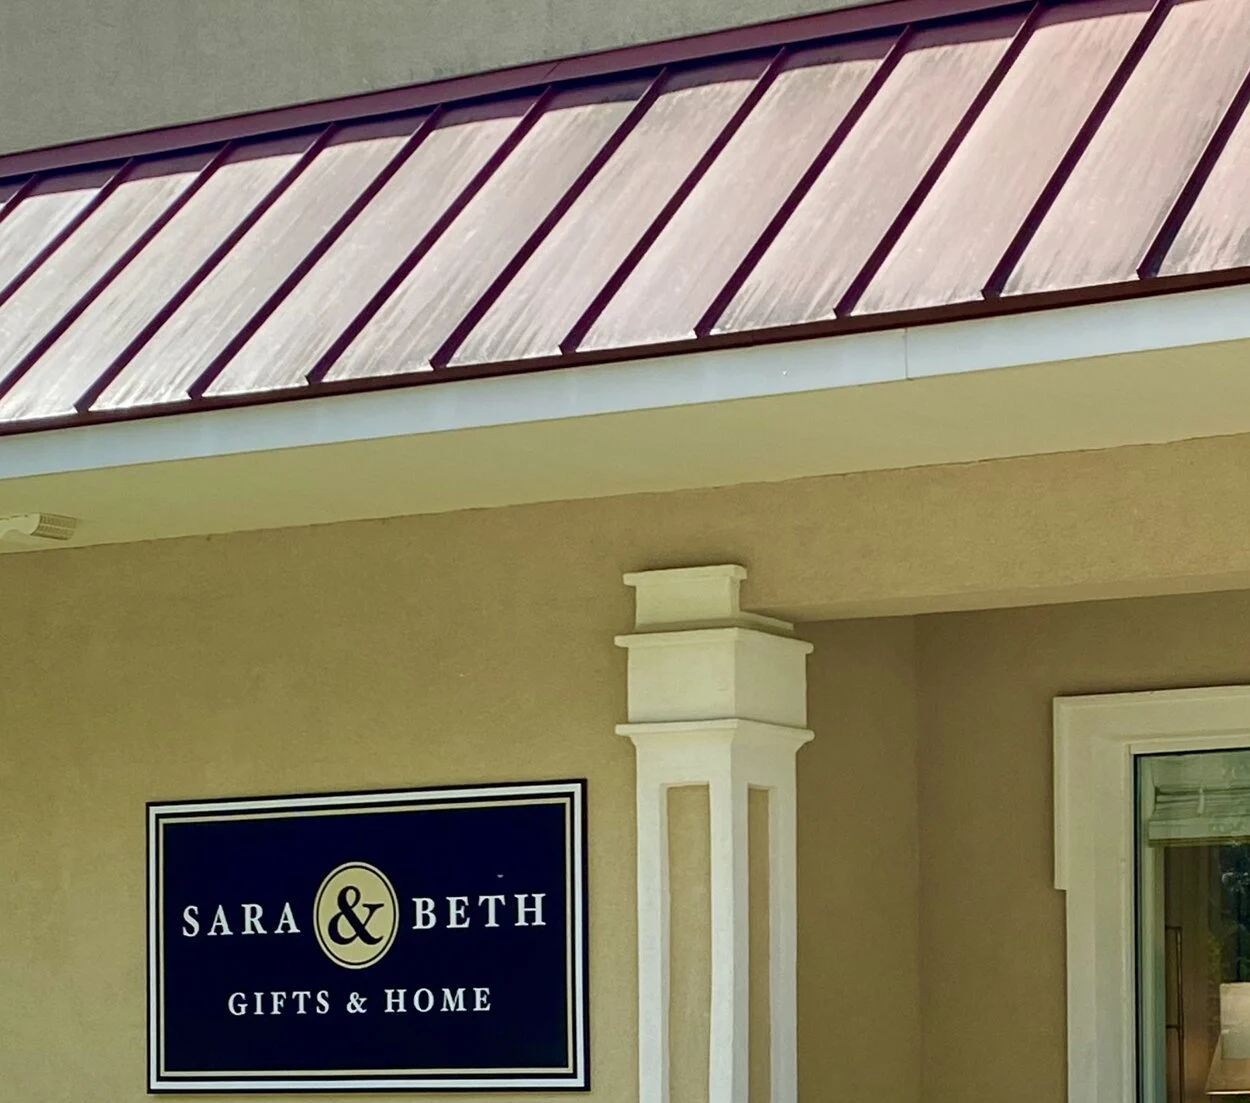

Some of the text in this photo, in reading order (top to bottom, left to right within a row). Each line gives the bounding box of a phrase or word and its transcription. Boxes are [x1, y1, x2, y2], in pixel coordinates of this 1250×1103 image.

[181, 885, 547, 946] SARA & BETH
[227, 987, 492, 1016] GIFTS & HOME
